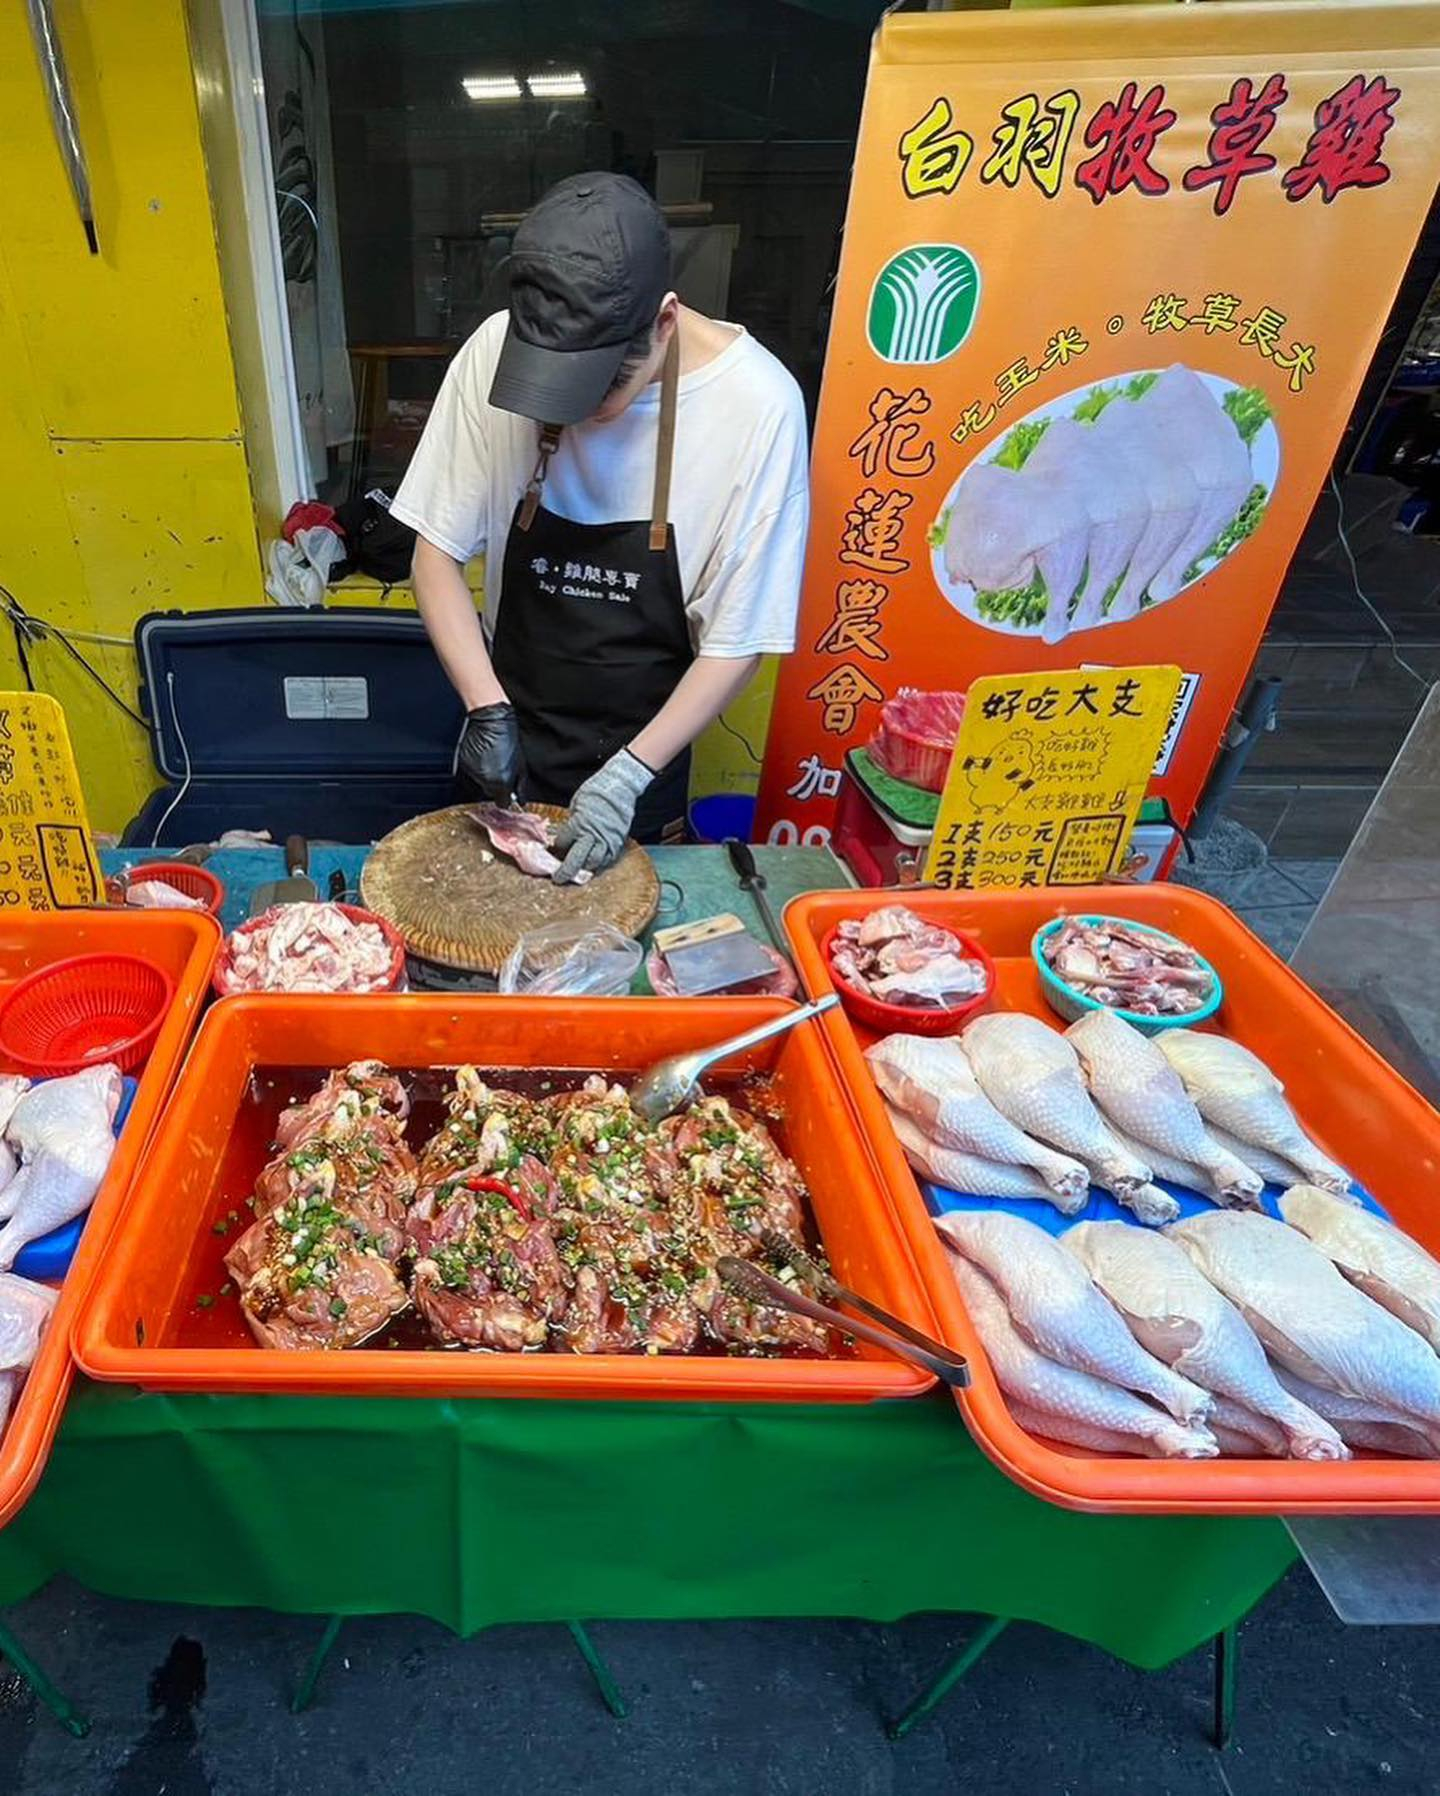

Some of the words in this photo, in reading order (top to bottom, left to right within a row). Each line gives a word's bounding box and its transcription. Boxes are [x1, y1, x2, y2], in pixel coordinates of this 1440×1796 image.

[900, 74, 1400, 215] 白羽牧草雞
[562, 585, 604, 599] Chicken
[808, 388, 935, 736] 花蓮農會
[982, 679, 1143, 722] 好吃大支
